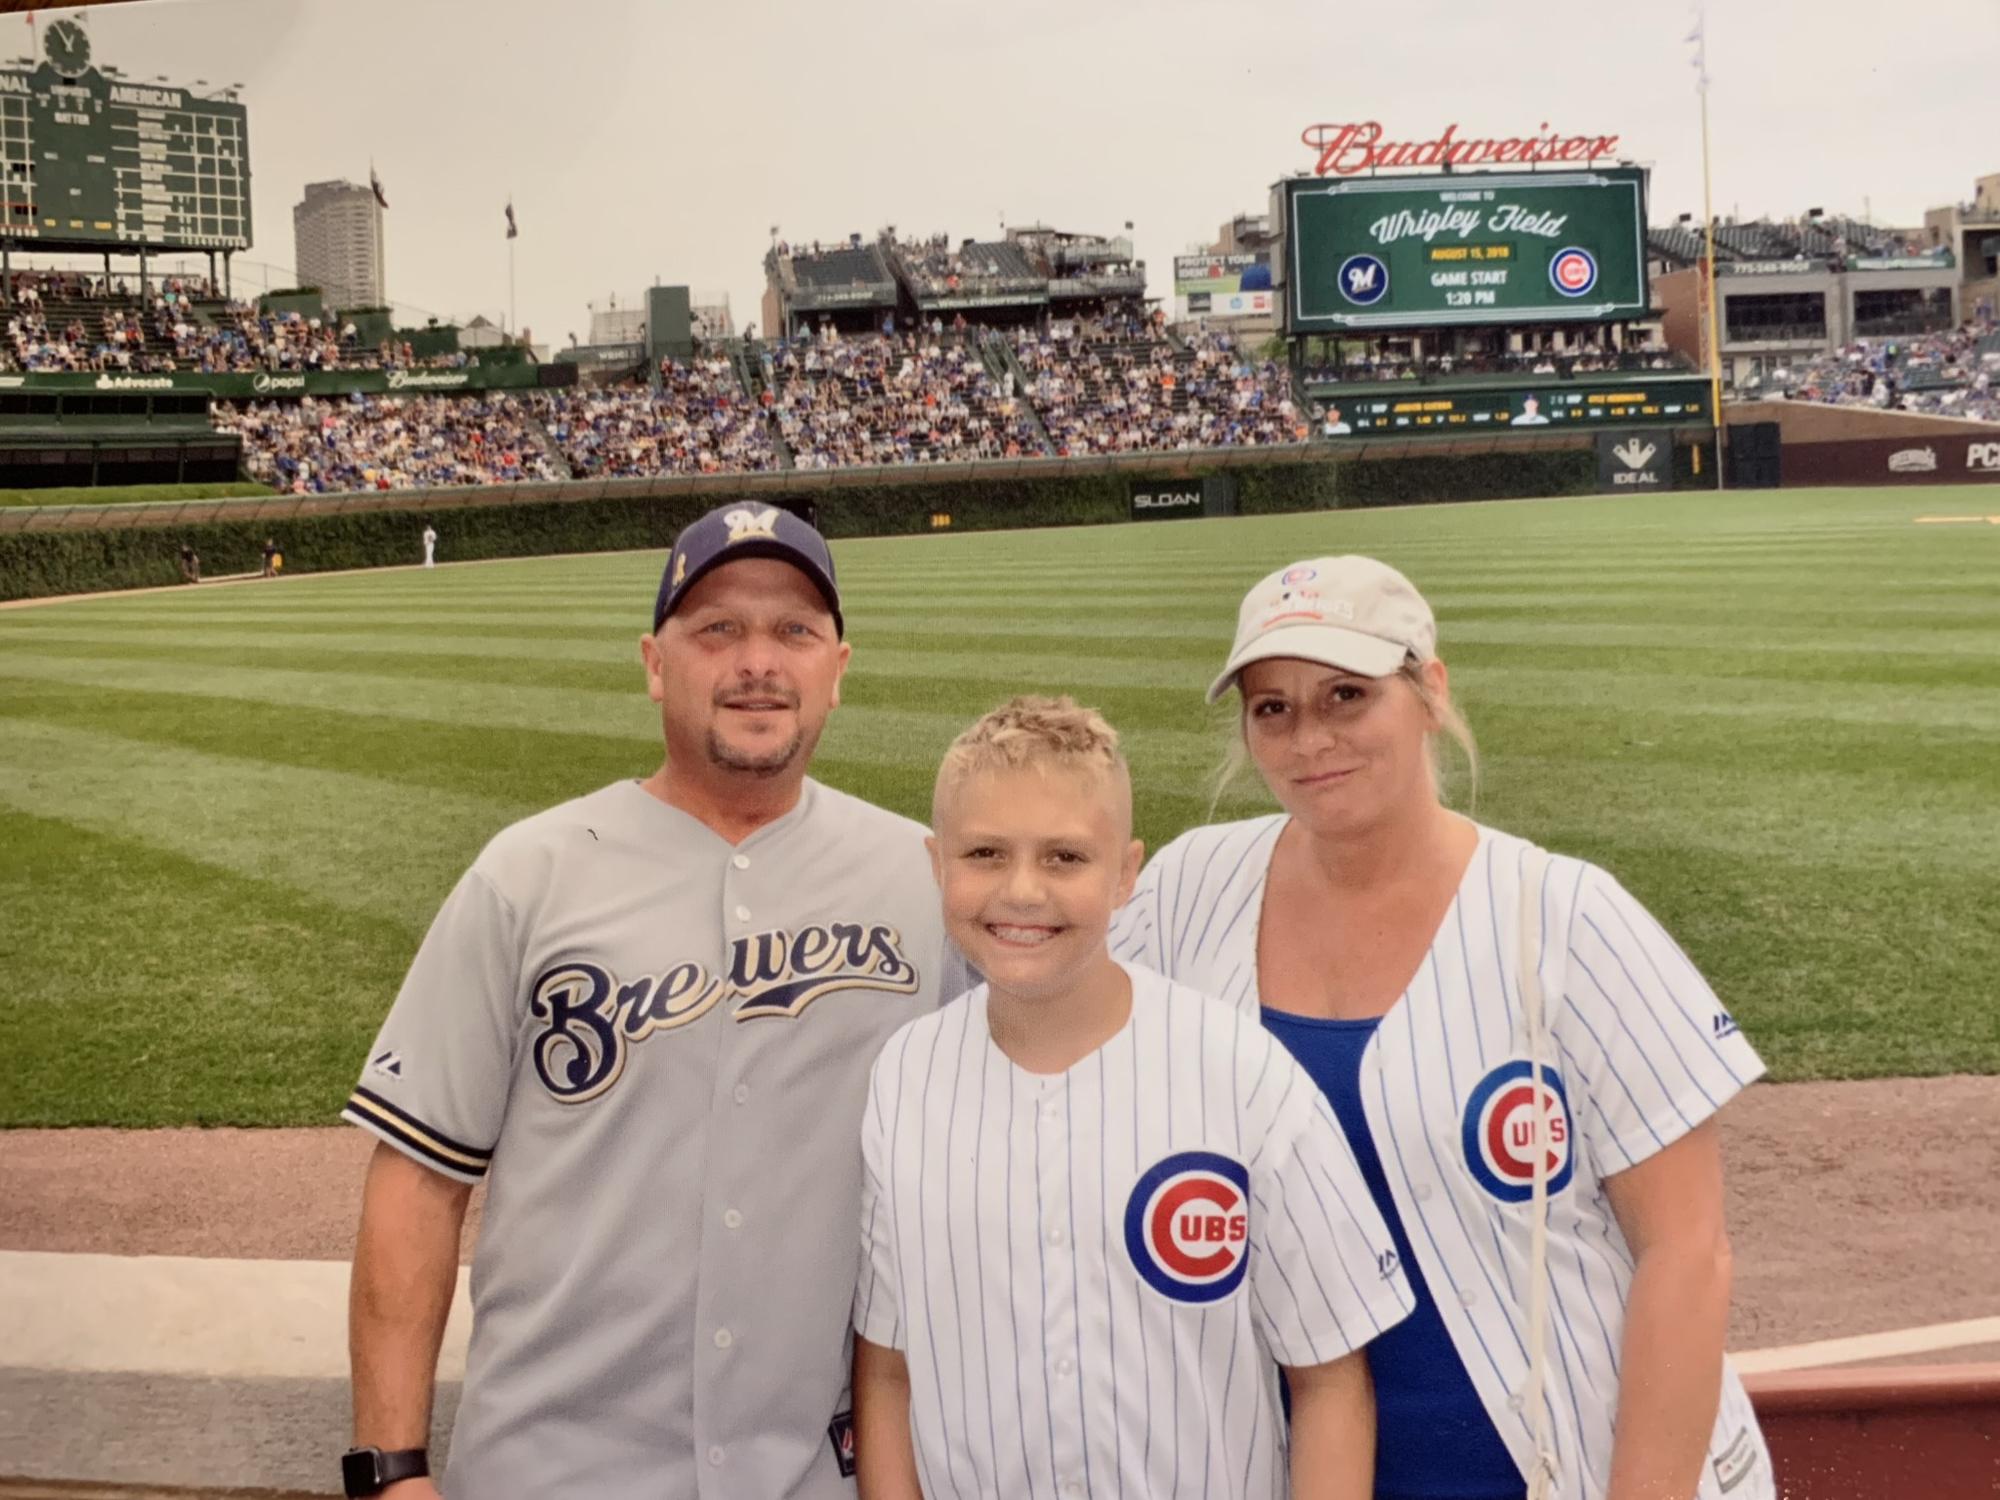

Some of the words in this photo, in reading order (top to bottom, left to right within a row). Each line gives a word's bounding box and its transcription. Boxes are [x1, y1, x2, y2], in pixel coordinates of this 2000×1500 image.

[109, 85, 182, 109] AMERICAN
[1301, 121, 1619, 175] Budweiser
[1440, 190, 1481, 202] WELCOME
[1483, 188, 1495, 201] TO
[1369, 203, 1481, 244] Wrigley
[1487, 203, 1569, 239] Field
[1431, 247, 1467, 260] AUGUST
[1431, 271, 1468, 287] GAME
[1470, 269, 1508, 286] START
[1445, 291, 1472, 305] 1:20
[1474, 290, 1495, 304] PM
[114, 376, 174, 389] Advocate
[271, 376, 305, 390] pepsi
[386, 370, 469, 389] Budweiser
[1613, 471, 1659, 484] IDEAL
[1133, 492, 1200, 508] SLOAN
[531, 921, 920, 1104] Brewers
[1488, 1085, 1566, 1179] CUS
[1151, 1177, 1247, 1278] CUBS
